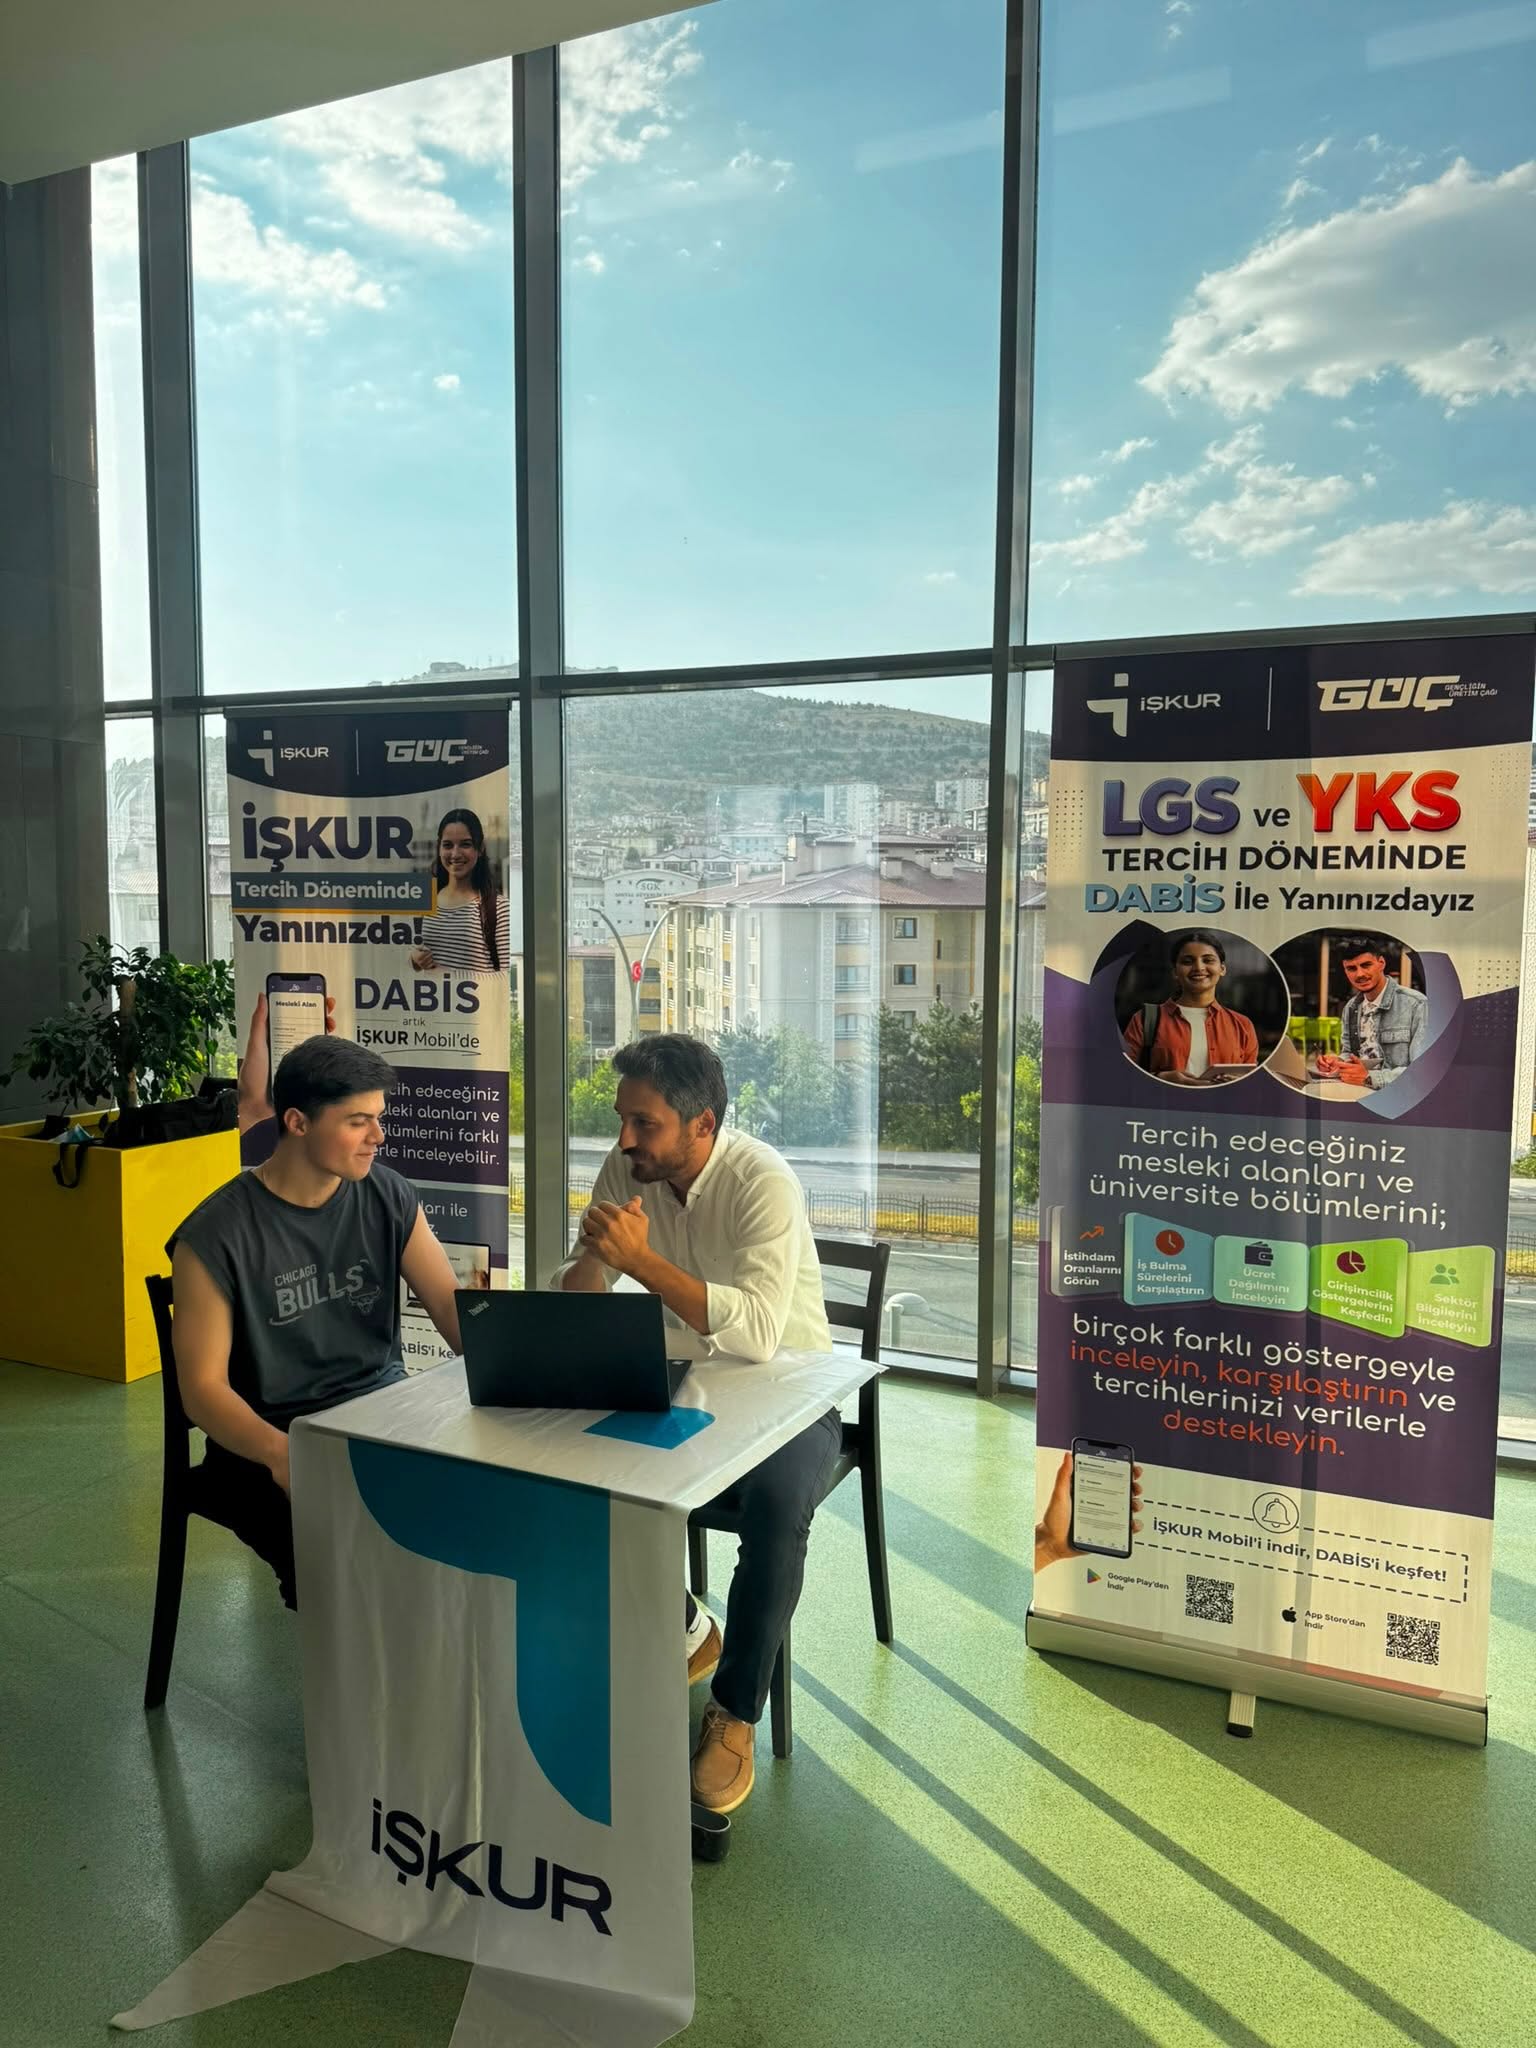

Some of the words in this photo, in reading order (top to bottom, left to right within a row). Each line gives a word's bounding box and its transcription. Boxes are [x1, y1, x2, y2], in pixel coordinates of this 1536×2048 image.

[1103, 777, 1241, 836] LGS
[1253, 805, 1291, 827] ve
[1296, 770, 1461, 834] YKS
[242, 801, 414, 873] İŞKUR
[1102, 841, 1227, 871] TERCİH
[1239, 838, 1467, 870] DÖNEMİNDE
[236, 880, 298, 899] Tercih
[304, 881, 422, 899] Döneminde
[1084, 873, 1225, 913] DABİS
[1234, 881, 1269, 911] İle
[1279, 886, 1474, 918] Yanınızdayız
[235, 914, 424, 945] Yanınızda!
[355, 973, 480, 1014] DABİS
[402, 1017, 426, 1027] artık
[356, 1025, 409, 1047] İŞKUR
[414, 1032, 480, 1048] Mobil'de
[415, 1084, 500, 1103] edeceğiniz
[417, 1105, 477, 1121] alanları
[482, 1111, 500, 1123] ve
[380, 1123, 453, 1140] ölümlerini
[458, 1128, 499, 1144] farklı
[1126, 1121, 1218, 1149] Tercih
[1229, 1130, 1406, 1164] edeceğiniz
[402, 1145, 500, 1165] inceleyebilir.
[1118, 1153, 1229, 1178] mesleki
[1241, 1159, 1365, 1190] alanları
[1377, 1173, 1414, 1193] ve
[450, 1202, 468, 1217] ile
[1090, 1174, 1239, 1207] üniversite
[1250, 1187, 1447, 1230] bölümlerini;
[1063, 1250, 1116, 1263] İstihdam
[1137, 1258, 1147, 1272] İş
[1150, 1261, 1187, 1271] Bulma
[274, 1263, 318, 1287] CHICAGO
[1063, 1264, 1122, 1275] Oranlarını
[1137, 1272, 1192, 1283] Sürelerini
[1243, 1266, 1276, 1280] Ücret
[275, 1265, 364, 1318] BULLS
[1063, 1276, 1100, 1287] Görün
[1136, 1284, 1205, 1296] Karşılaştırın
[1228, 1279, 1290, 1293] Dağılımını
[1327, 1279, 1394, 1301] Girişimcilik
[1231, 1290, 1286, 1305] İnceleyin
[1312, 1288, 1393, 1313] Göstergelerini
[1434, 1292, 1479, 1309] Sektör
[1340, 1305, 1393, 1325] Keşfedin
[1415, 1303, 1478, 1322] Bilgilerini
[1417, 1314, 1476, 1335] İnceleyin
[400, 1341, 435, 1357] ABİS'i
[1073, 1312, 1164, 1346] birçok
[1174, 1326, 1251, 1357] farklı
[1263, 1341, 1456, 1385] göstergeyle
[1071, 1339, 1208, 1384] inceleyin,
[1218, 1360, 1408, 1407] karşılaştırın
[1419, 1392, 1456, 1412] ve
[1093, 1371, 1283, 1418] tercihlerinizi
[1293, 1405, 1426, 1438] verilerle
[1163, 1409, 1345, 1456] destekleyin.
[1153, 1516, 1203, 1539] İŞKUR
[1208, 1530, 1263, 1550] Mobil'i
[1267, 1539, 1311, 1560] indir,
[1316, 1548, 1380, 1571] DABİS'i
[1385, 1560, 1447, 1583] keşfet!
[1107, 1572, 1135, 1585] Google
[1136, 1577, 1169, 1590] Play'den
[1107, 1581, 1125, 1592] İndir
[1304, 1609, 1323, 1622] App
[1324, 1613, 1366, 1629] Store'dan
[1304, 1619, 1324, 1631] İndir
